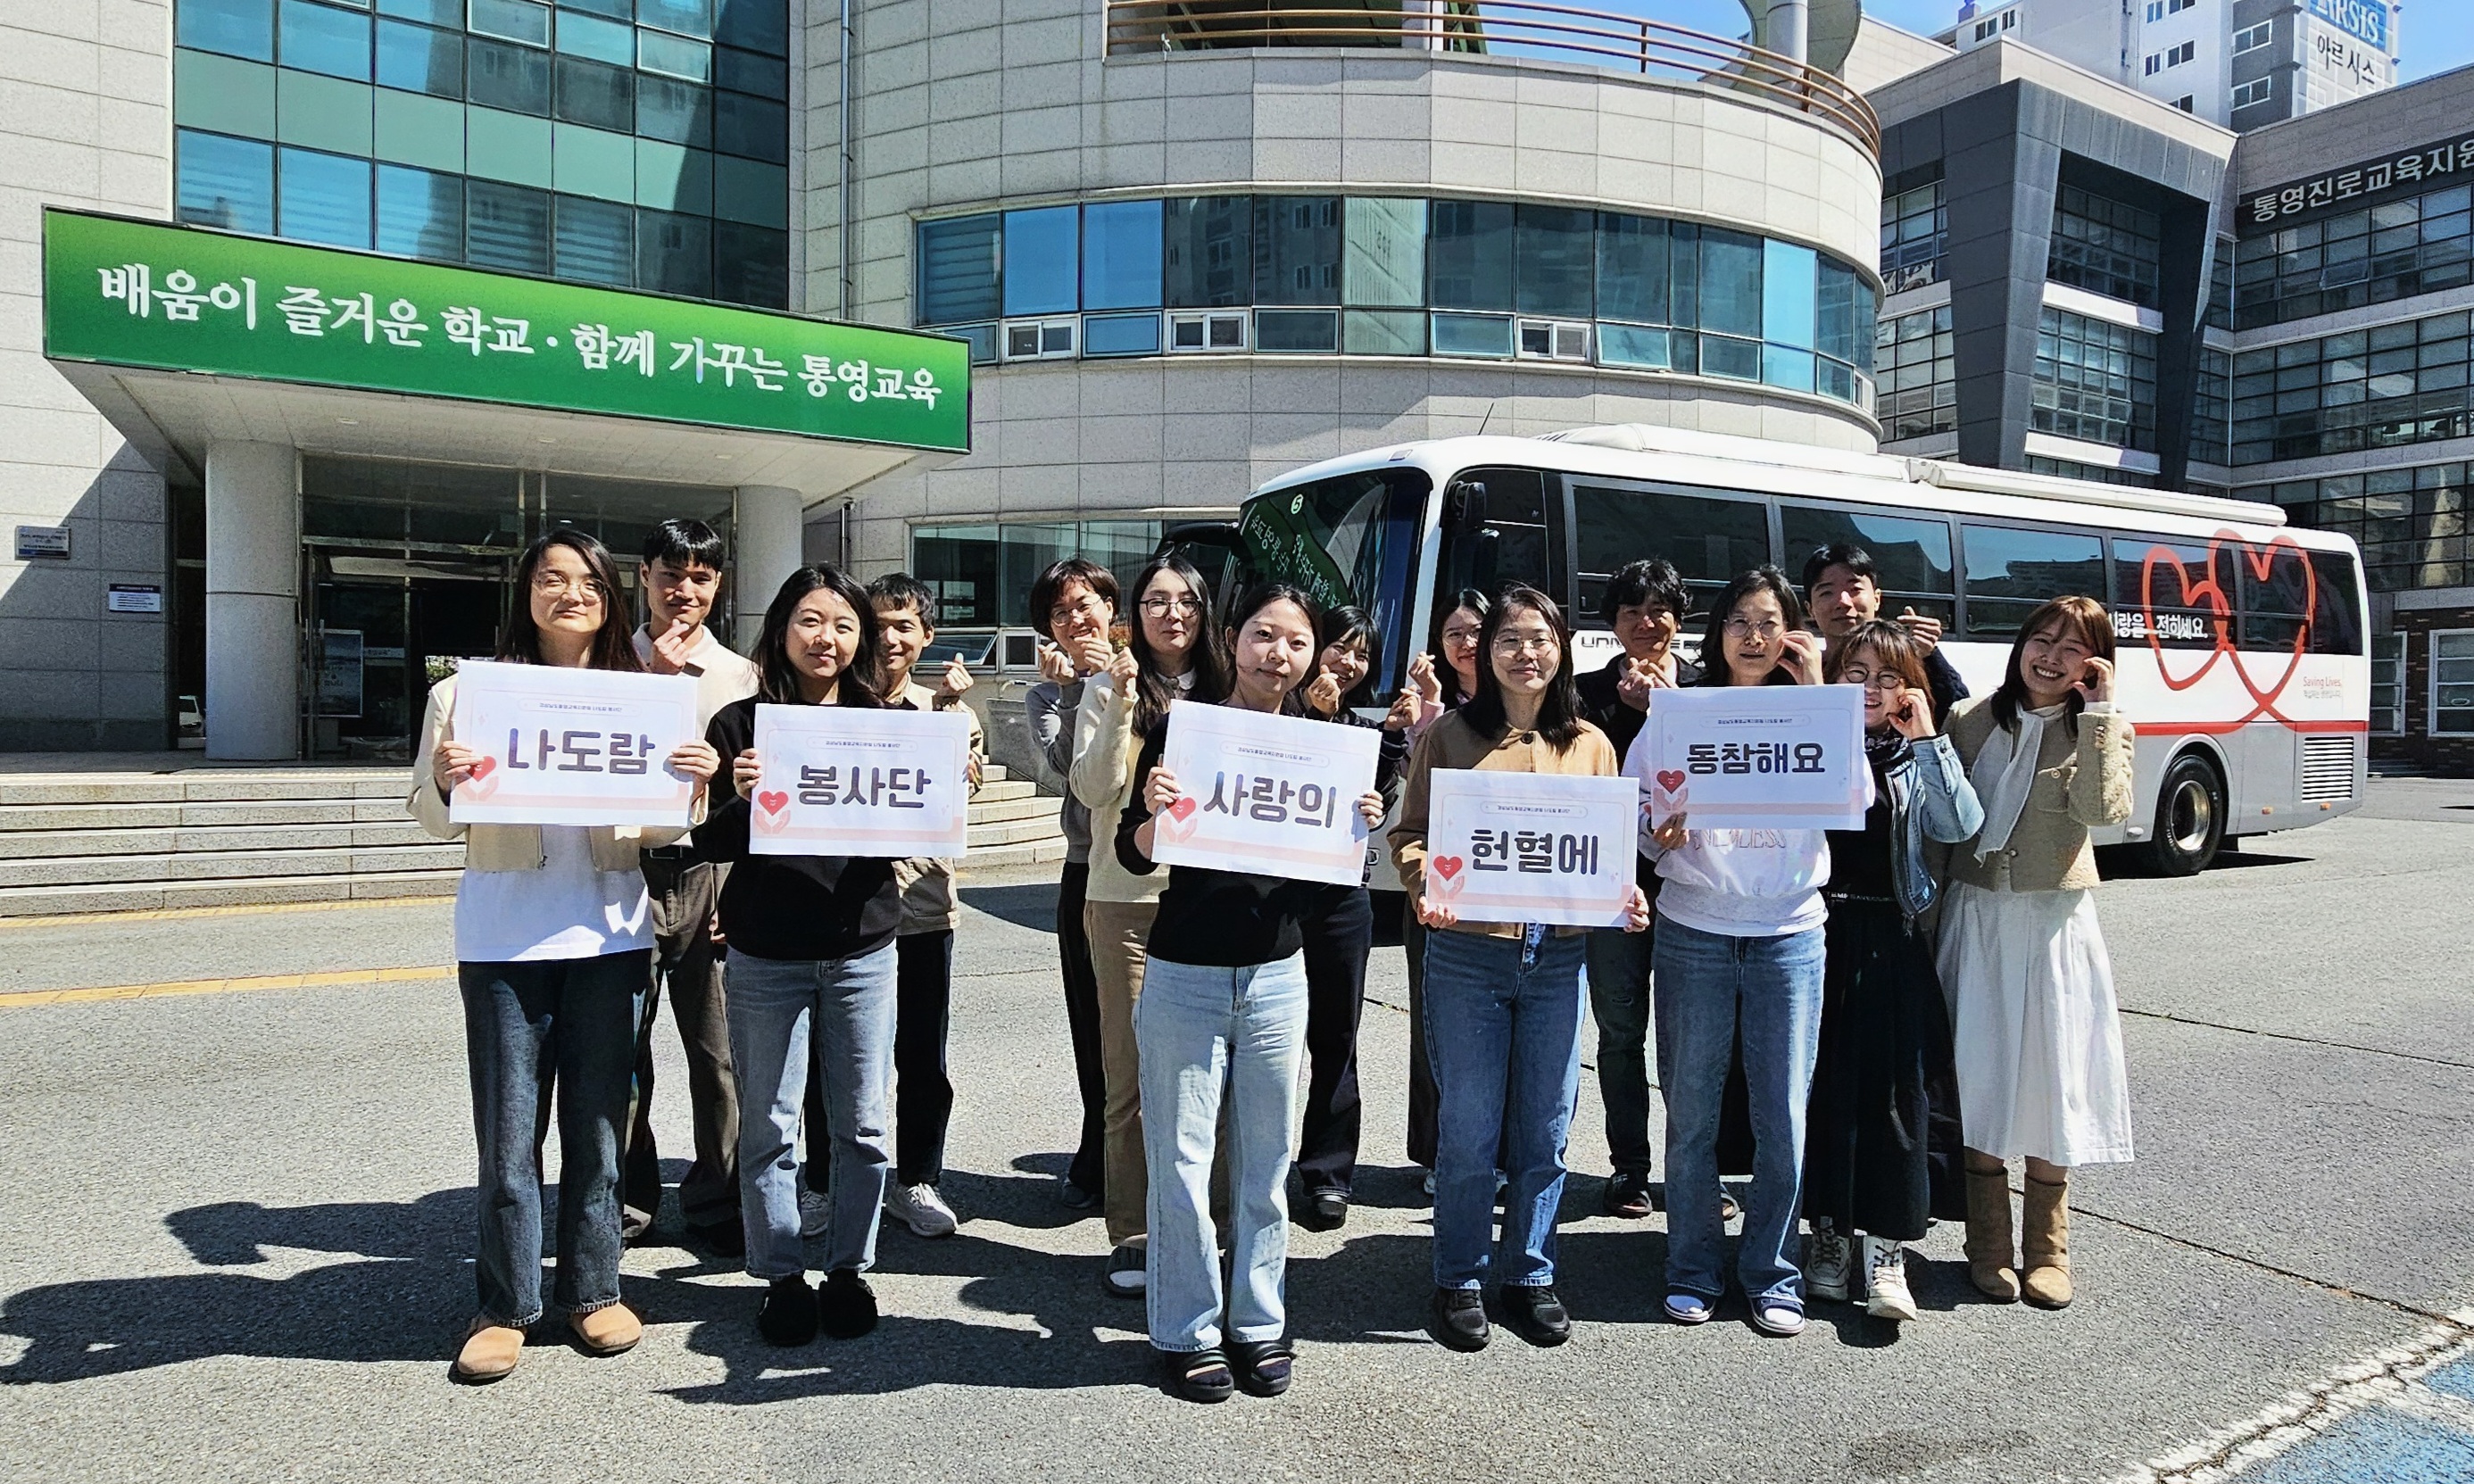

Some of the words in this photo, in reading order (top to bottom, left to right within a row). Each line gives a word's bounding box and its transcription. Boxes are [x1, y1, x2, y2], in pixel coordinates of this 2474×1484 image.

[97, 263, 256, 330] 배움이
[276, 286, 429, 347] 즐거운
[440, 306, 535, 356] 학교
[570, 323, 654, 377] 함께
[669, 336, 789, 391] 가꾸는
[797, 354, 942, 411] 통영교육
[2304, 676, 2324, 689] Saving
[508, 727, 656, 775] 나도람
[1687, 742, 1825, 774] 동참해요
[797, 764, 932, 808] 봉사단
[1203, 771, 1337, 828] 사랑의
[1470, 829, 1598, 875] 헌혈에
